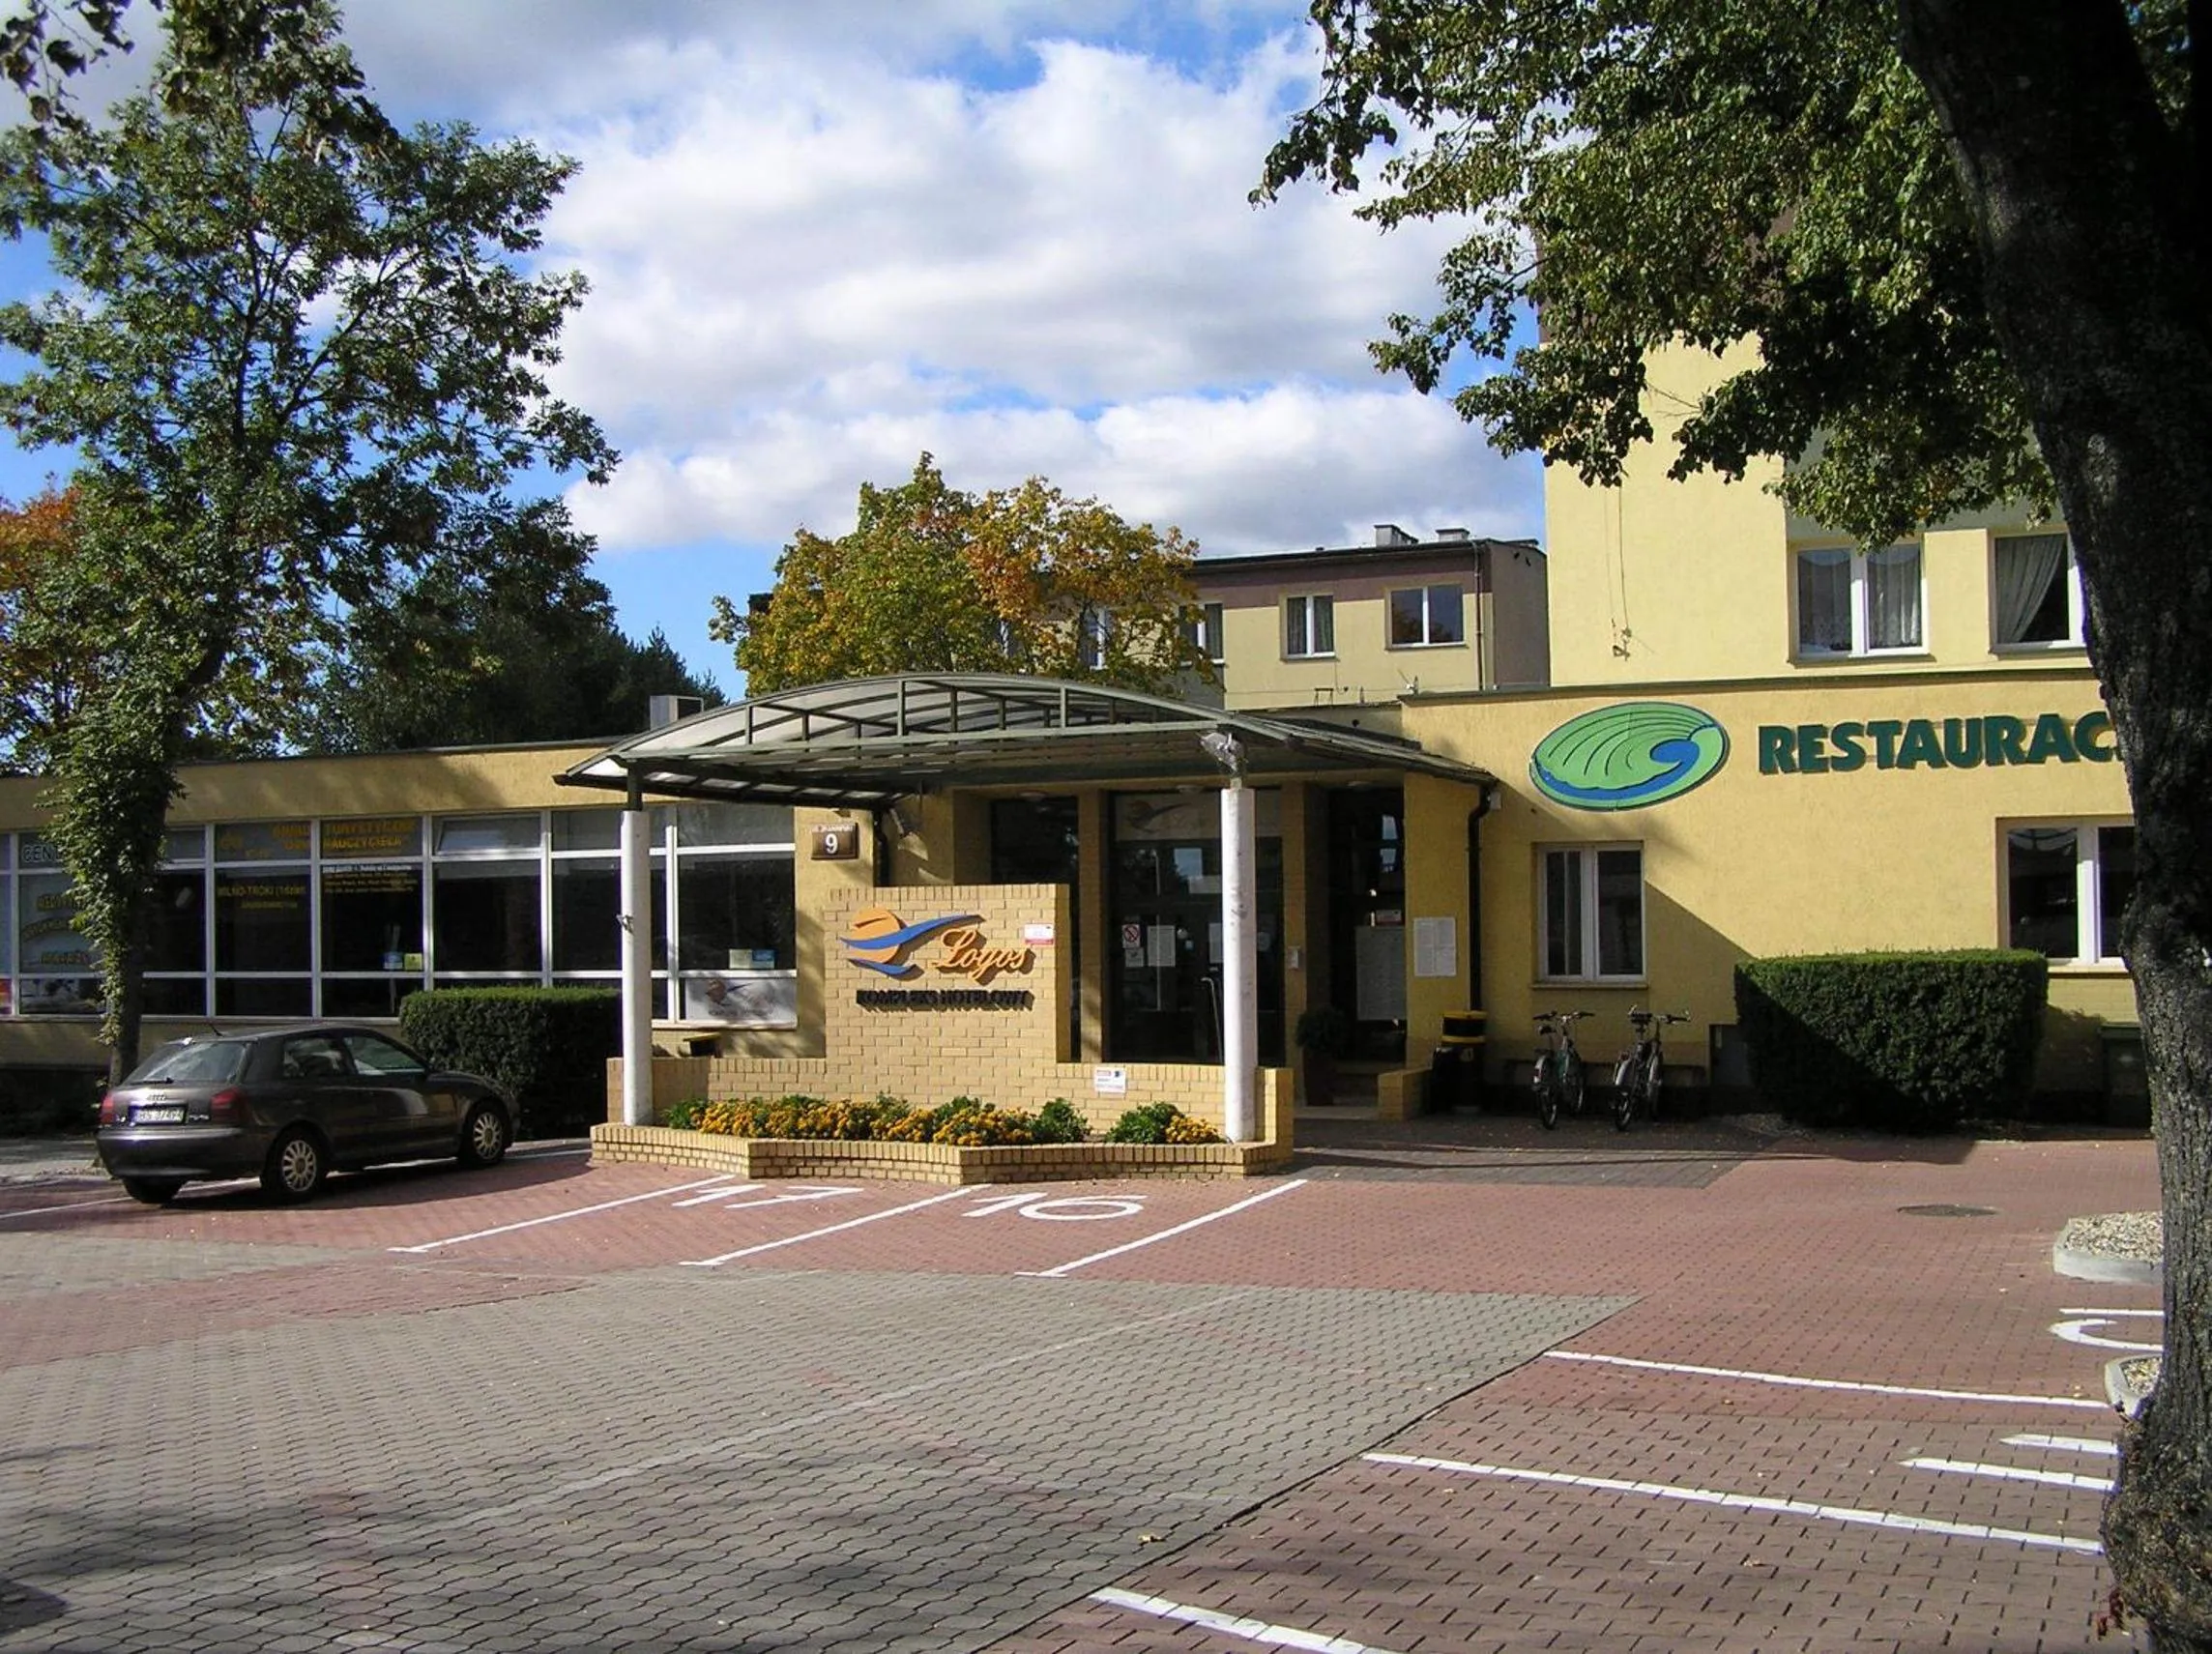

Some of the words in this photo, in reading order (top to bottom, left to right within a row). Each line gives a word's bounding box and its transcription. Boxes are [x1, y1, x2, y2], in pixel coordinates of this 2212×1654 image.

[1759, 711, 2124, 774] RESTAURAC
[825, 832, 838, 855] 9
[931, 928, 1026, 980] Logos
[672, 1183, 864, 1208] 17
[961, 1191, 1149, 1221] 16
